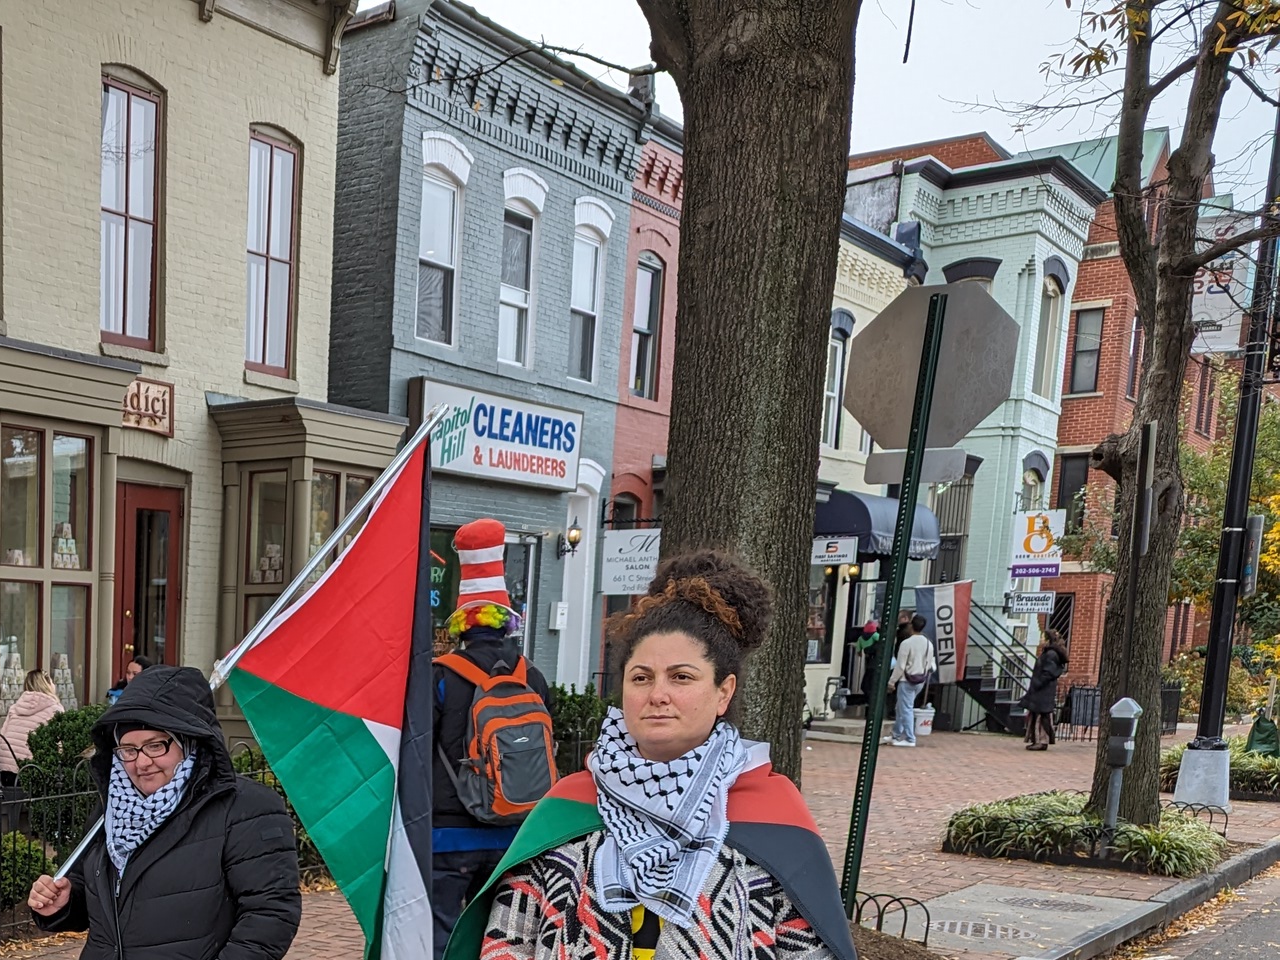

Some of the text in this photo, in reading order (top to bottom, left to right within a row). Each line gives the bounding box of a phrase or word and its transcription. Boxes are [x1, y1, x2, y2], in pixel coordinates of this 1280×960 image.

[440, 428, 466, 466] Hill
[473, 403, 576, 453] CLEANERS
[473, 445, 567, 479] & LAUNDERERS
[1016, 594, 1051, 602] Bravado
[937, 605, 955, 666] OPEN
